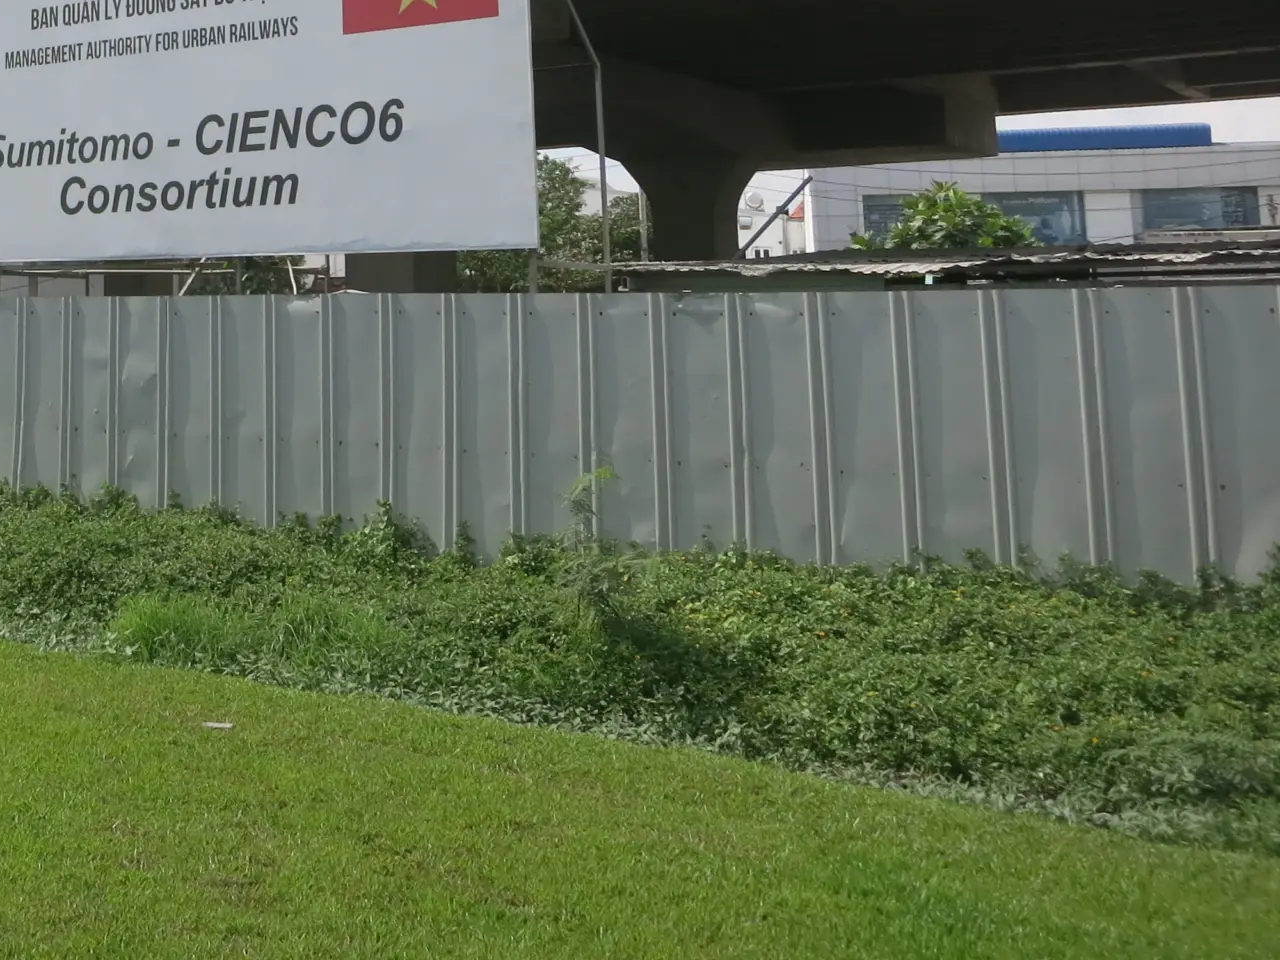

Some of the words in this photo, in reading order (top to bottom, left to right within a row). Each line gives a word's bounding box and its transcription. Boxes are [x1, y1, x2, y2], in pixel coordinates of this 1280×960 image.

[5, 42, 84, 70] MANAGEMENT
[86, 34, 152, 60] AUTHORITY
[155, 31, 179, 52] FOR
[182, 25, 226, 49] URBAN
[229, 16, 299, 43] RAILWAYS
[31, 5, 59, 30] BAN
[167, 138, 181, 148] -
[195, 98, 405, 155] CIENCO6
[60, 167, 300, 216] Consortium
